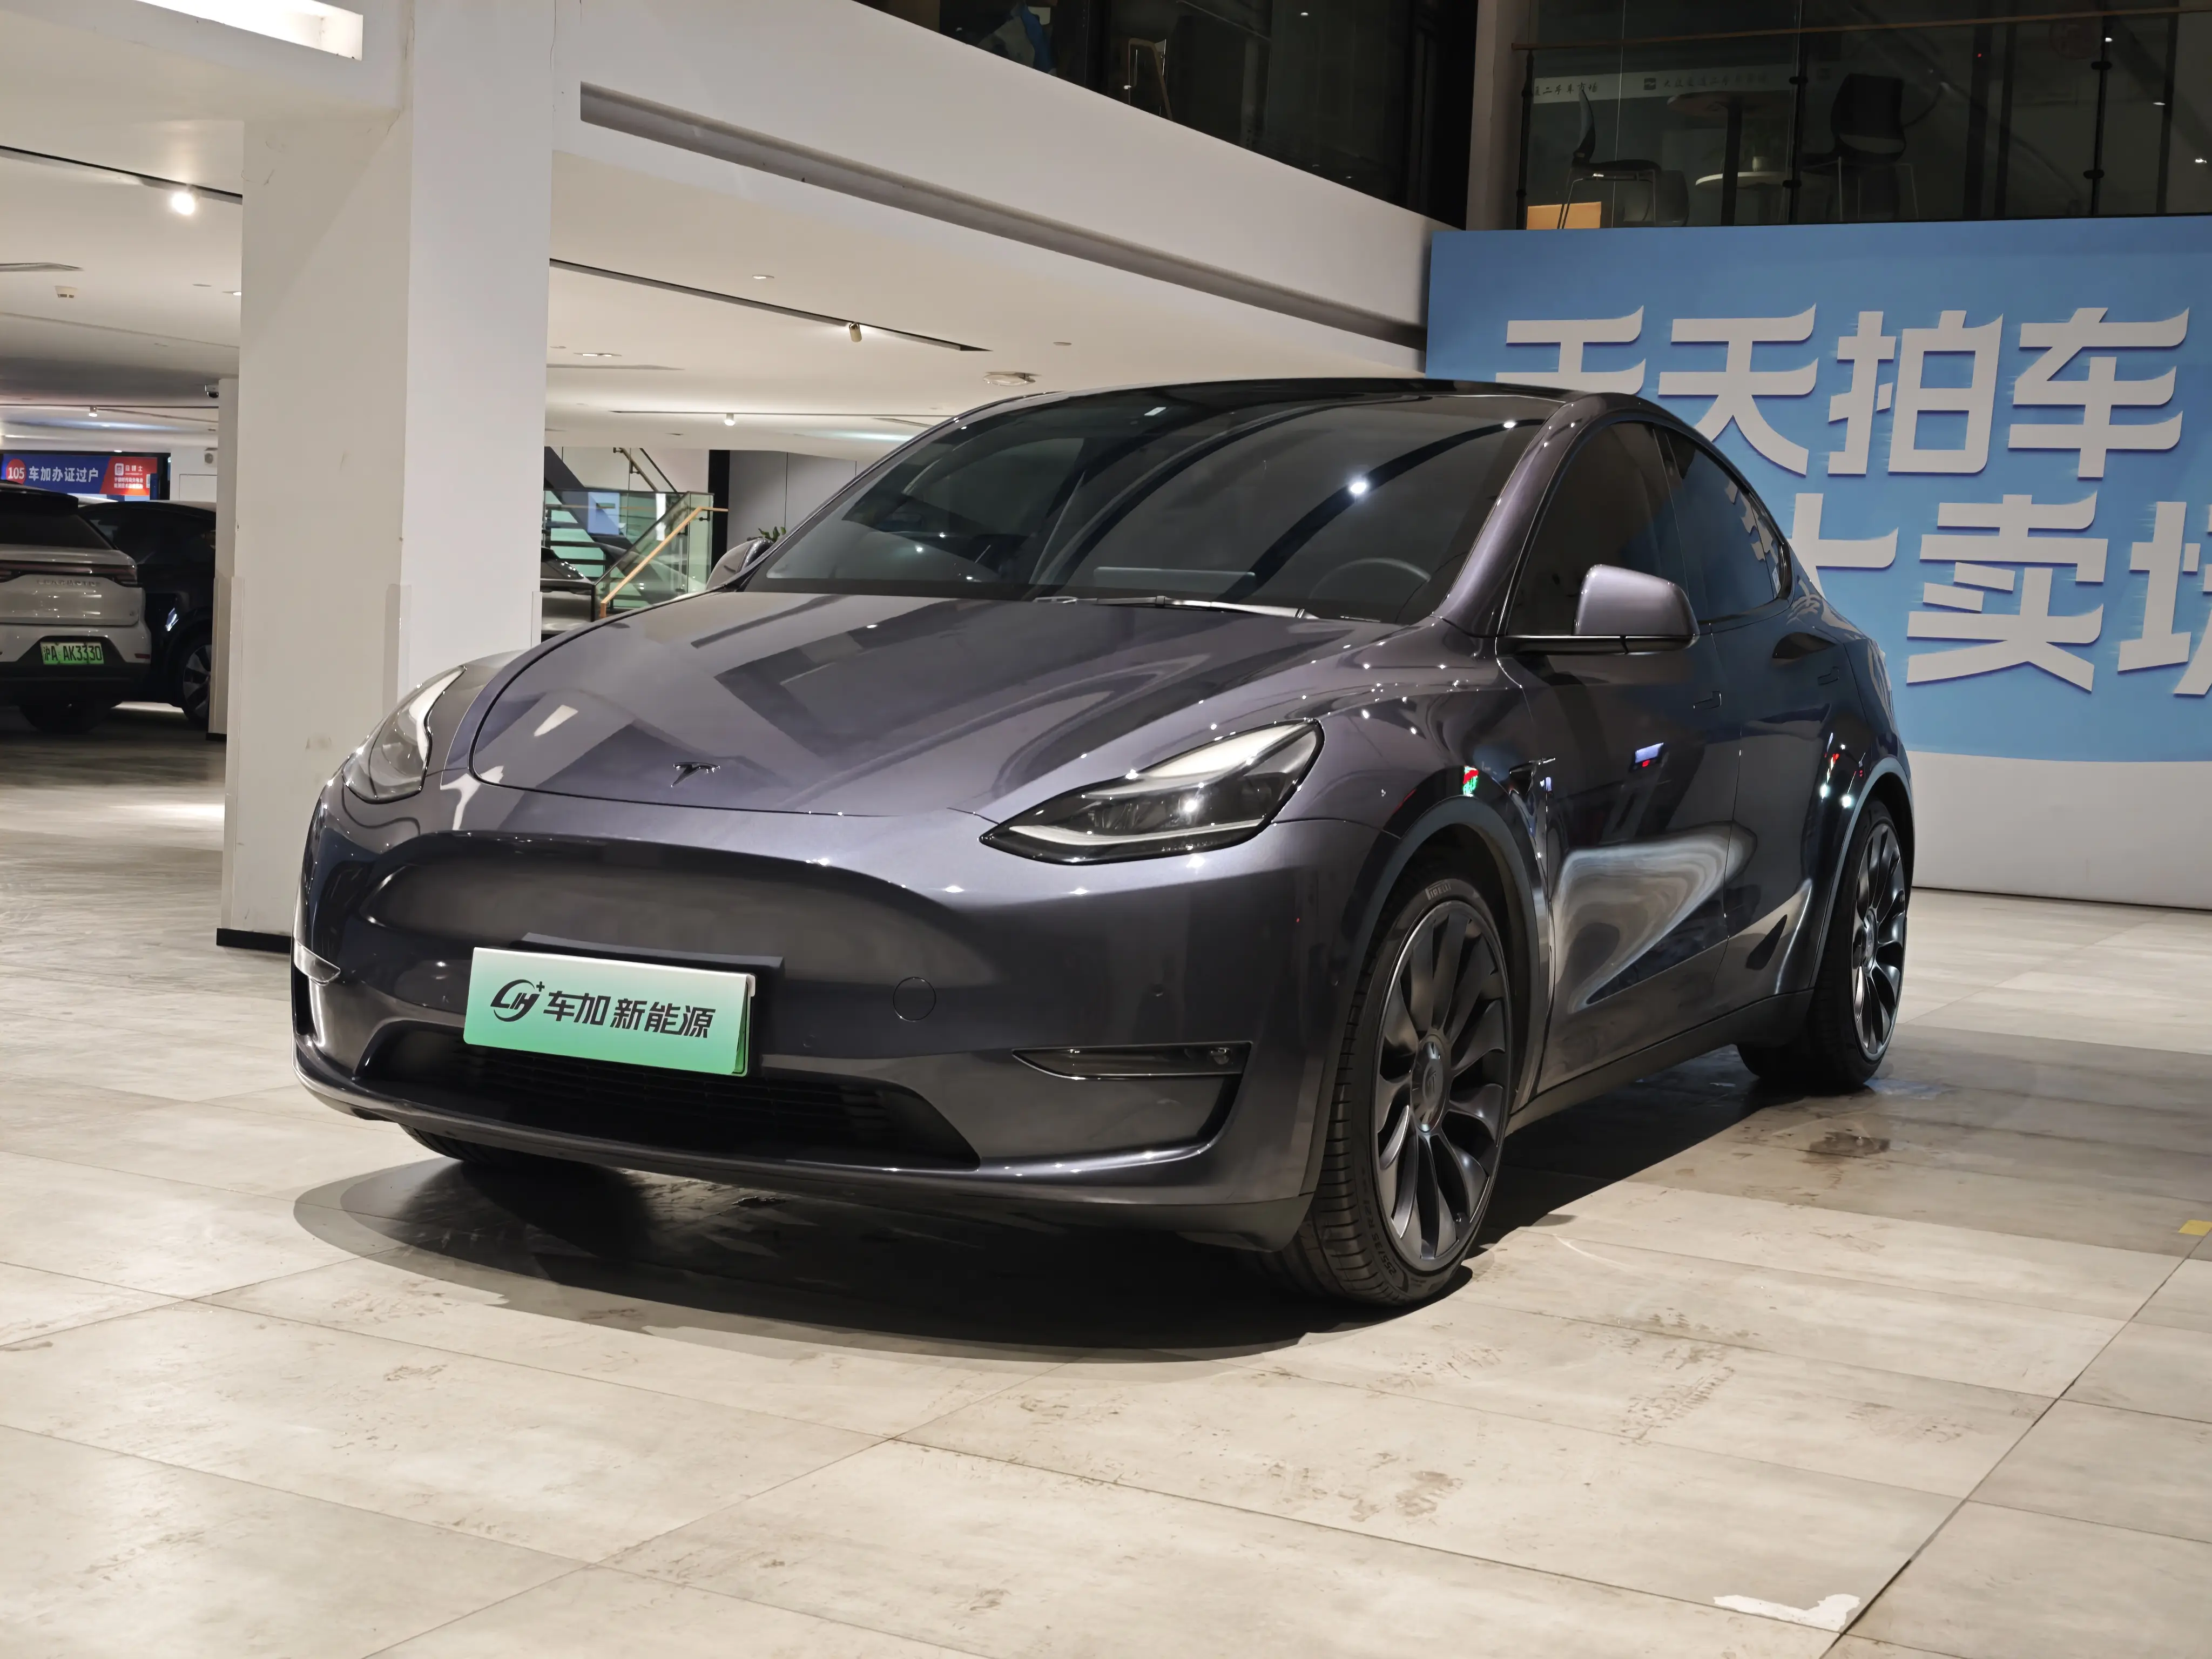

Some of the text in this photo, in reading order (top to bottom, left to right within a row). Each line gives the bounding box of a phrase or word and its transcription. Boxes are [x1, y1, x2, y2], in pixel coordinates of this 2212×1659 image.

[8, 466, 99, 482] 105 车加办证过户
[63, 645, 102, 660] AK3330
